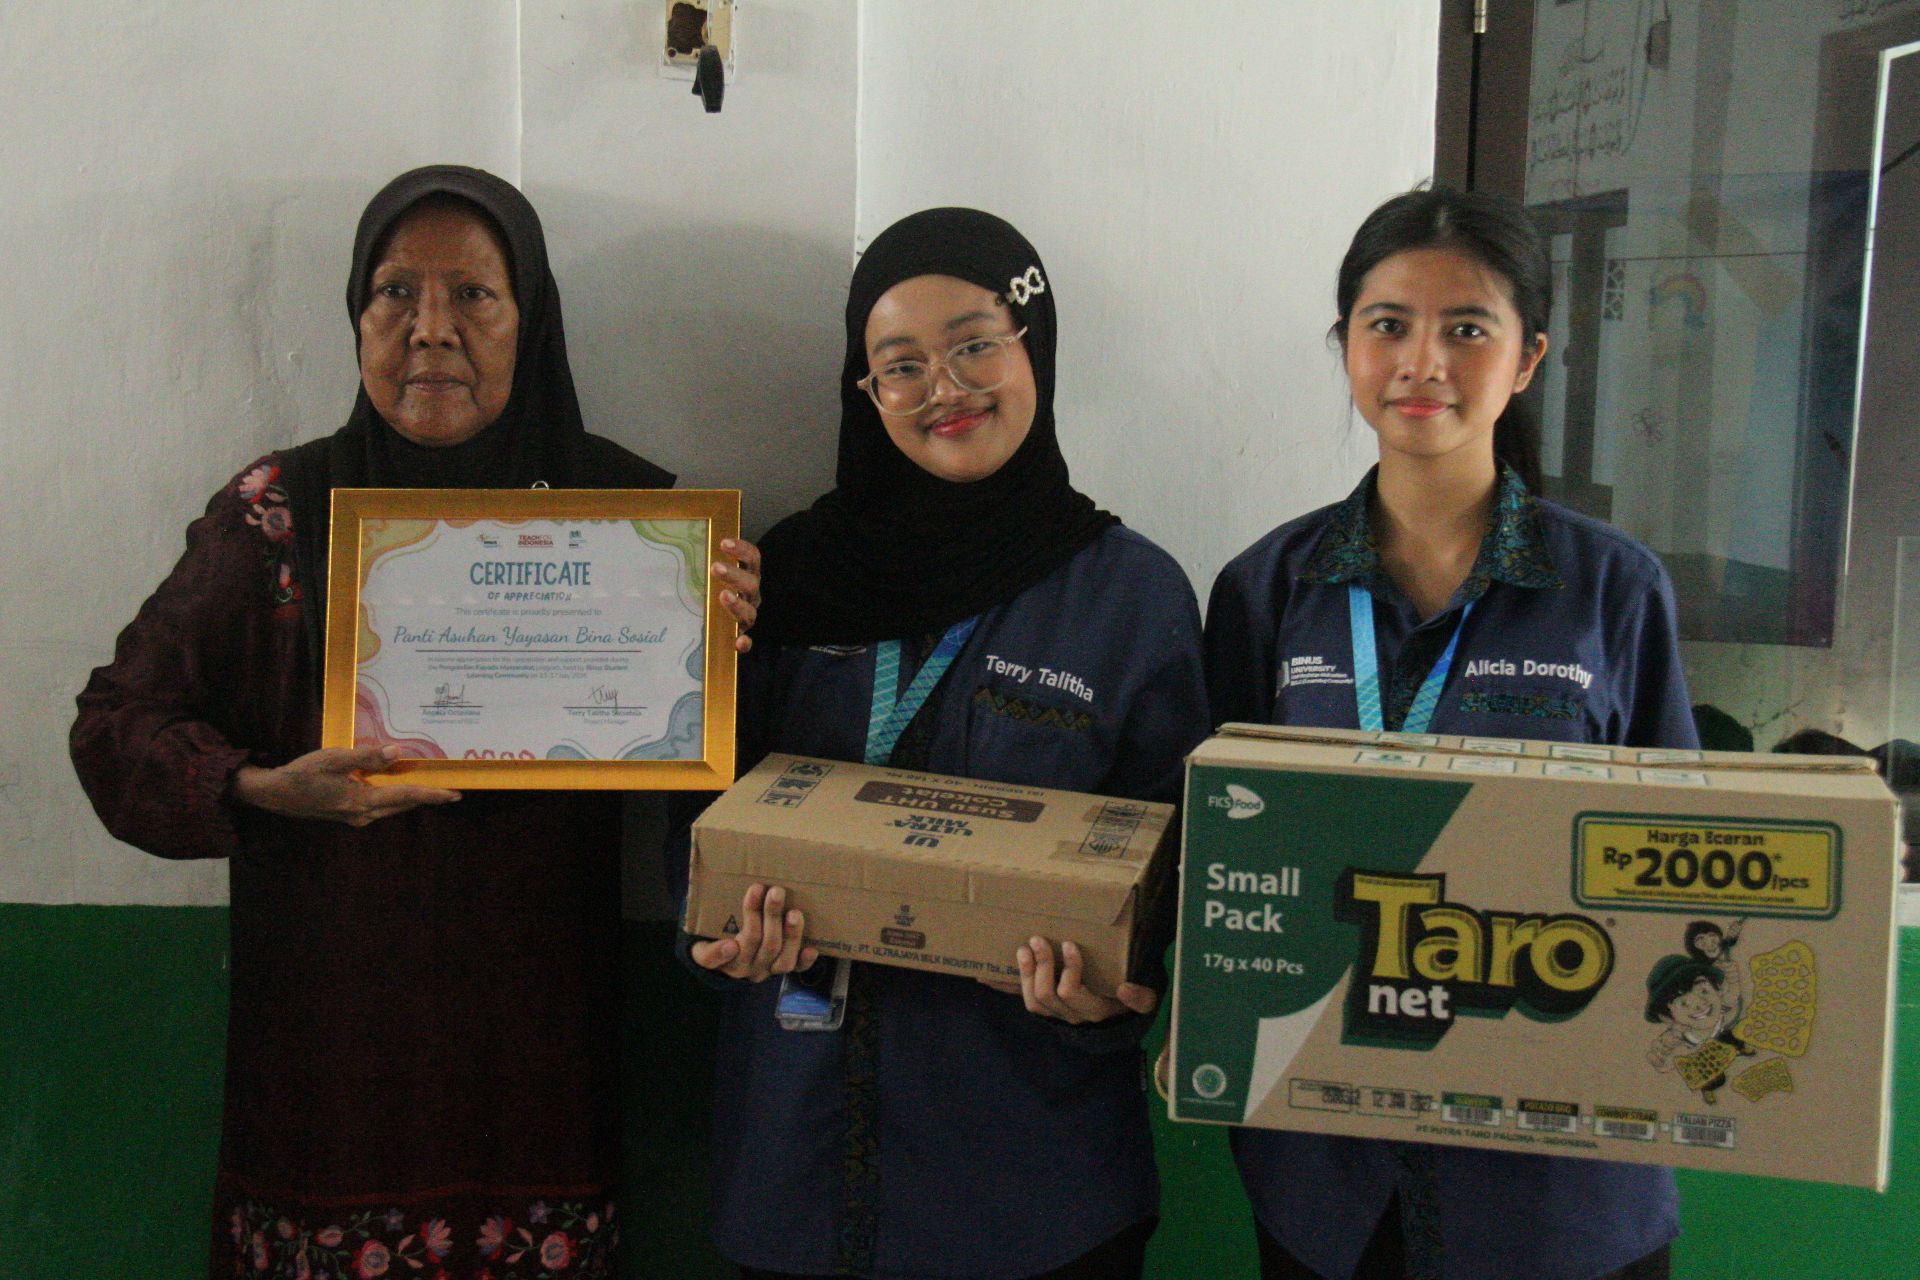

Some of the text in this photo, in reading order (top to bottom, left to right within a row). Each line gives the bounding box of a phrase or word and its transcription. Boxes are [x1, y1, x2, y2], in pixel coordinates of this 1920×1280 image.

[469, 561, 591, 586] CERTIFICATE
[487, 591, 572, 601] OF APPRECIATION
[393, 625, 668, 647] Panti Asuhan Yayasan Bina Sosial
[1291, 656, 1323, 666] BINUS
[1291, 665, 1337, 674] UNIVERSITY
[986, 654, 1095, 703] Terry Talitha
[1464, 659, 1594, 689] Alicia Dorothy
[878, 795, 1017, 819] Susu UHT
[900, 787, 1009, 808] Cokelat
[1207, 796, 1261, 810] FKS Food
[894, 819, 974, 837] ULTRA
[909, 814, 969, 828] MILK
[1647, 829, 1765, 847] Harga Eceran
[1207, 863, 1300, 897] Small
[1204, 901, 1284, 933] Pack
[1352, 872, 1611, 993] Taro
[1203, 953, 1234, 973] 17g
[1251, 957, 1273, 972] 40
[1276, 958, 1304, 975] Pcs
[1367, 984, 1449, 1019] net
